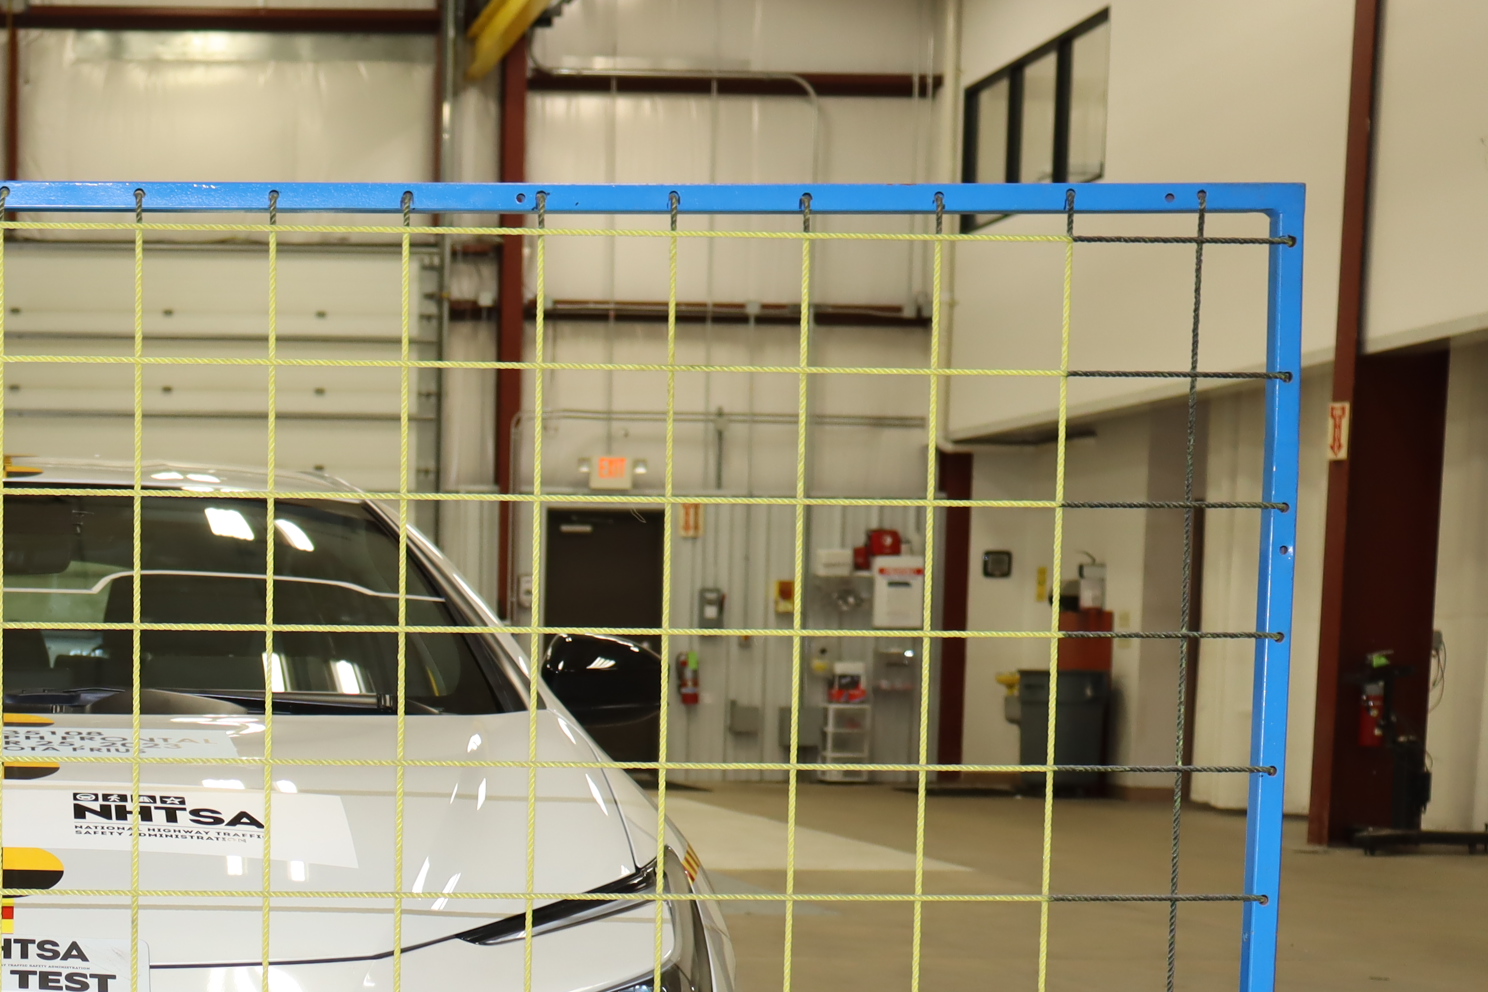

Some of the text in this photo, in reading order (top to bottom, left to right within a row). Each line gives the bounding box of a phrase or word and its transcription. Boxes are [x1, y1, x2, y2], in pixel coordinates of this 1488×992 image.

[60, 735, 218, 744] FRONTAL
[73, 803, 265, 829] NHTSA
[147, 827, 210, 835] HIGHWAY
[215, 831, 264, 839] TRAFFI
[10, 970, 116, 992] TEST
